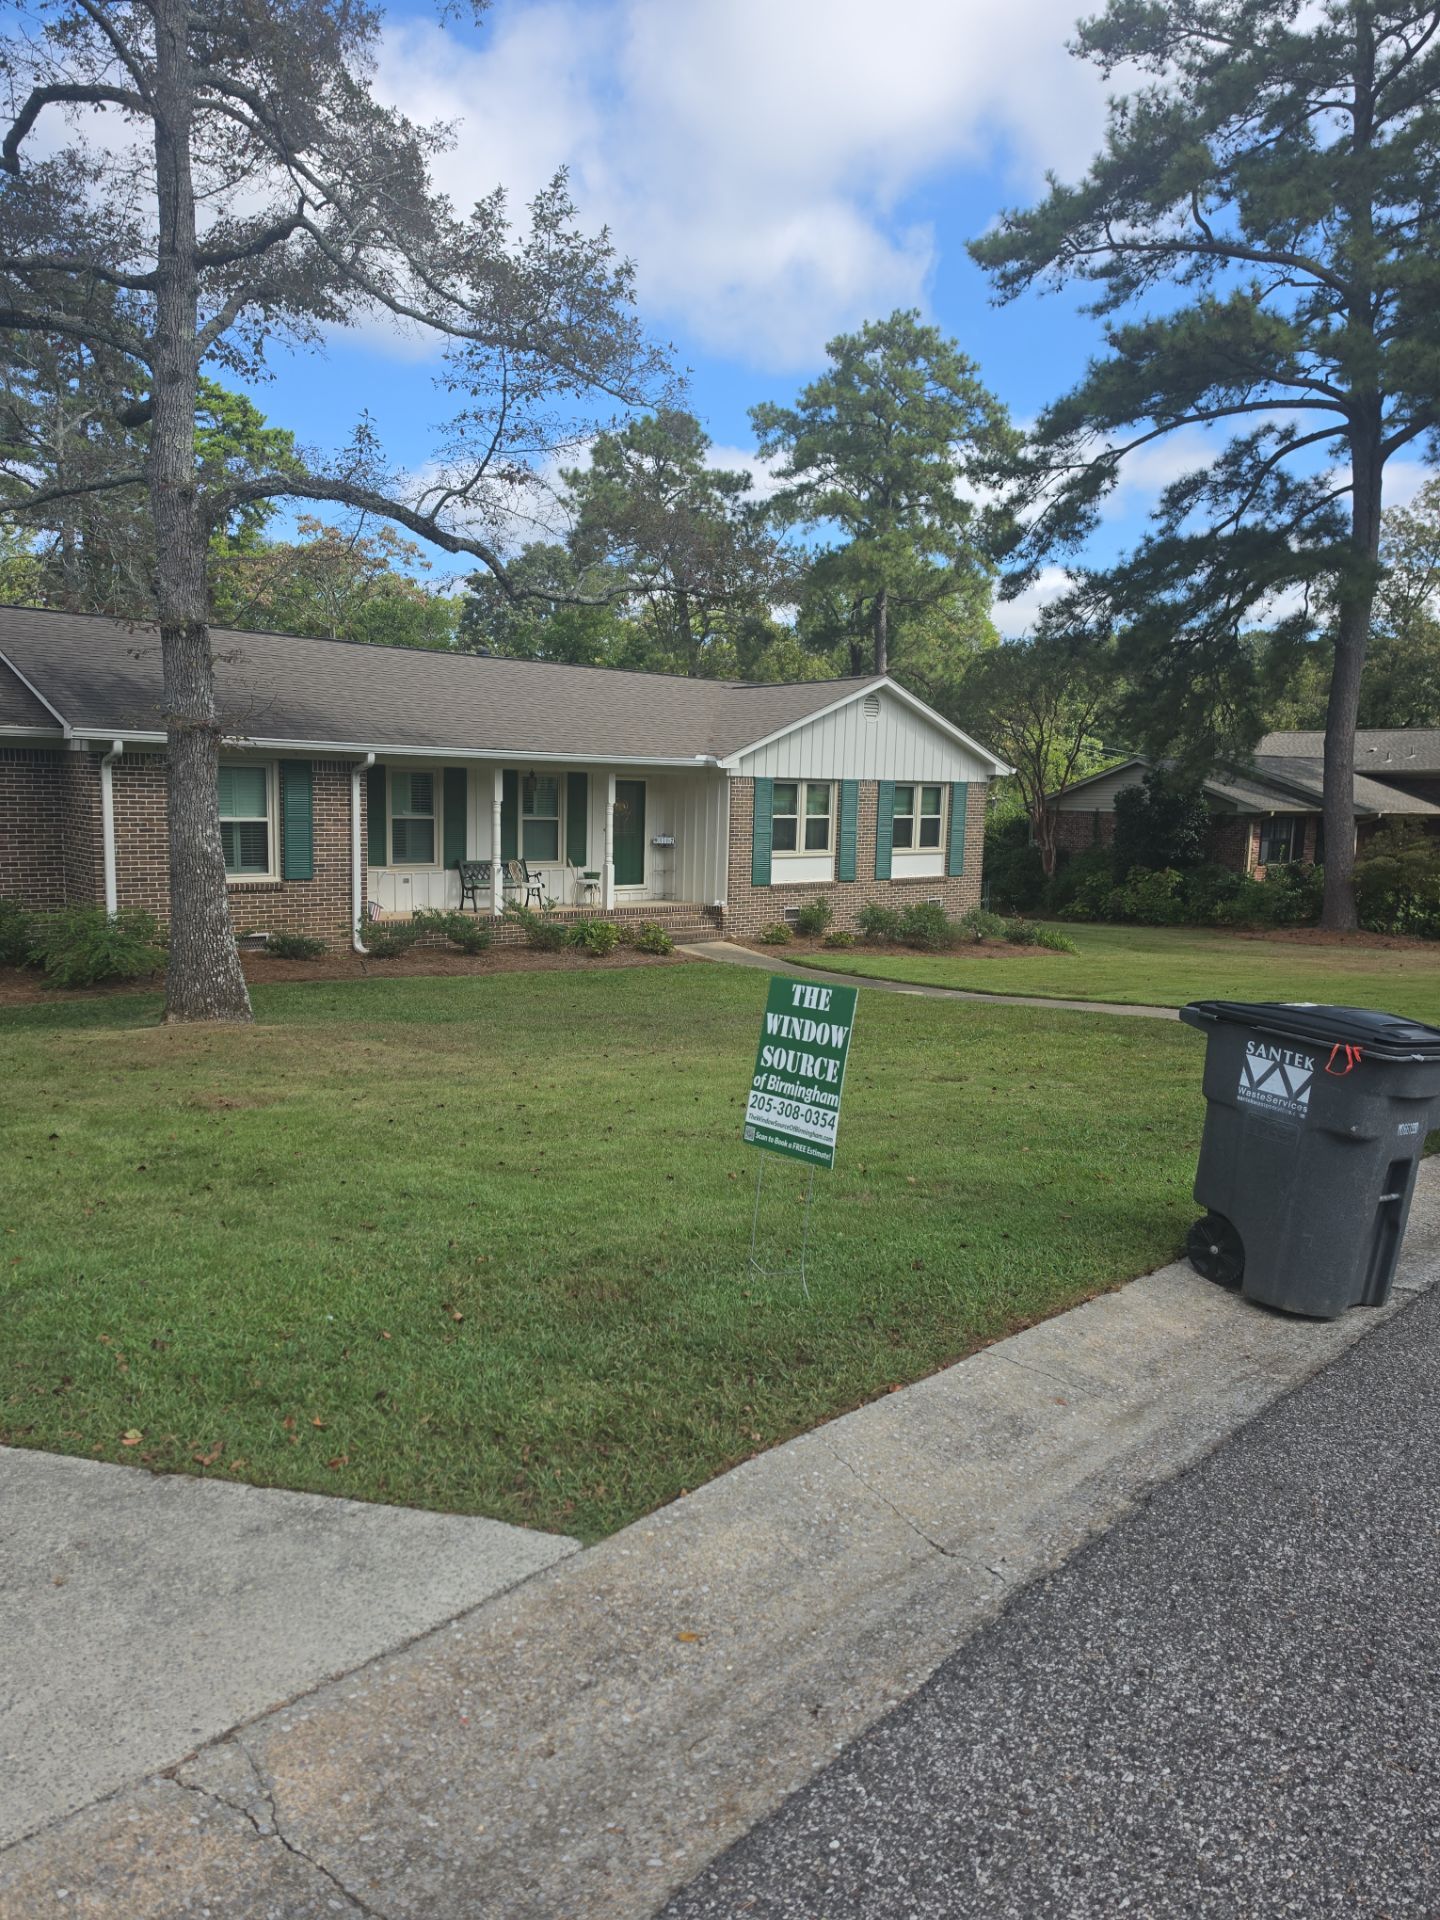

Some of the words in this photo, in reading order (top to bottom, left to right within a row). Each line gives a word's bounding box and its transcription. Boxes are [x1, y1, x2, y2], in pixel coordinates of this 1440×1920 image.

[792, 984, 833, 1011] THE
[767, 1013, 849, 1049] WINDOW
[760, 1045, 840, 1084] SOURCE
[1246, 1040, 1315, 1071] SANTEK
[753, 1073, 768, 1090] of
[767, 1074, 839, 1107] Birmingham
[1238, 1086, 1308, 1113] WasteServices
[749, 1094, 836, 1131] 205-308-0354
[755, 1132, 768, 1141] Scan
[768, 1135, 774, 1143] to
[774, 1137, 788, 1148] Book
[792, 1142, 807, 1152] FREE
[807, 1147, 832, 1161] Estimate!
